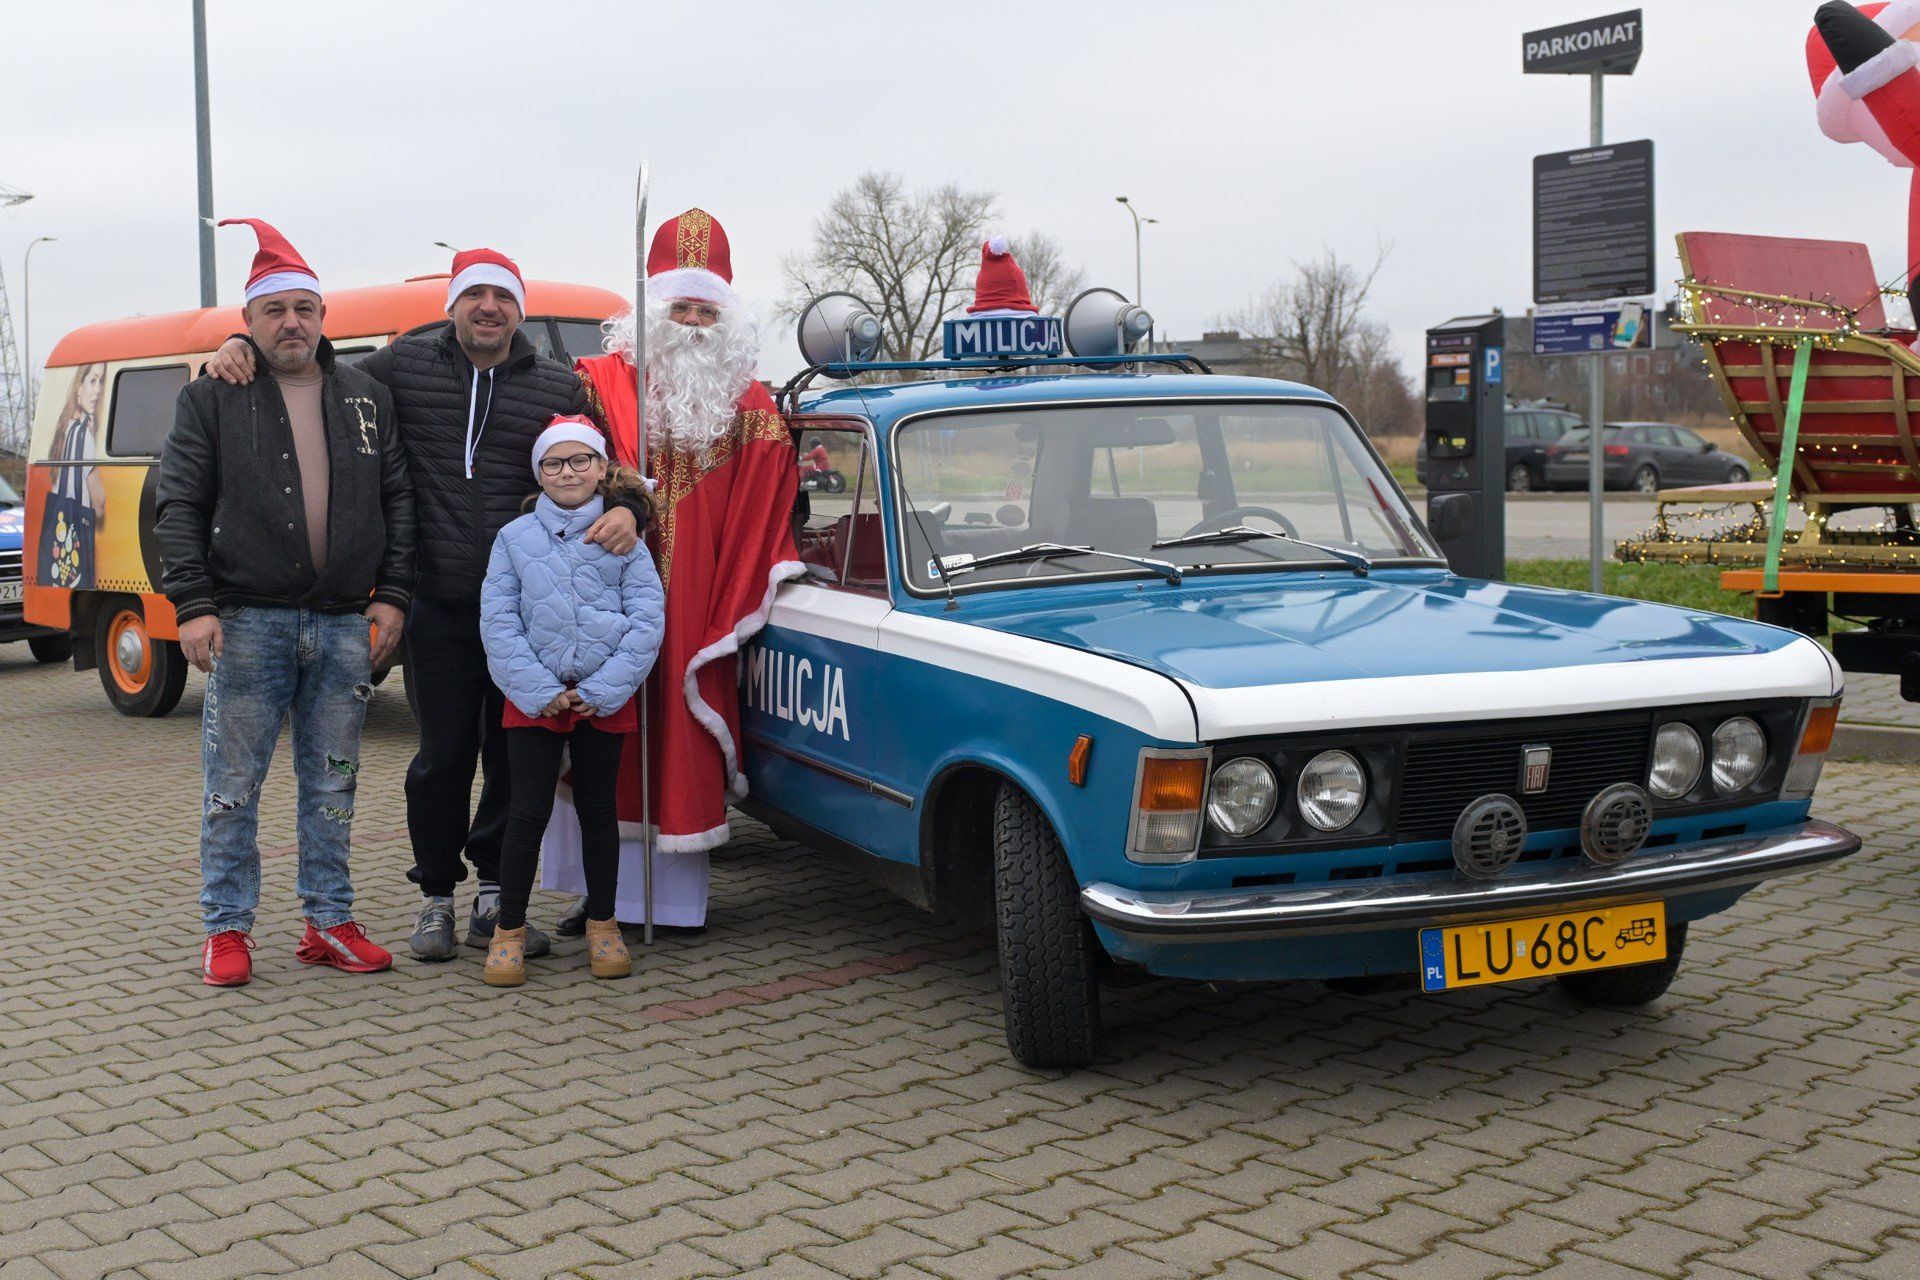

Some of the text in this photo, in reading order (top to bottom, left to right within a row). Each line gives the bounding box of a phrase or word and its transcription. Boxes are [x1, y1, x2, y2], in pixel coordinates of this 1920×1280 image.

[1526, 21, 1637, 61] PARKOMAT
[955, 319, 1061, 355] MILICJA
[1487, 349, 1499, 377] P
[747, 643, 850, 741] MILICJA
[1526, 765, 1546, 789] FIAT
[1454, 916, 1606, 981] LU 68C
[1427, 966, 1443, 980] PL
